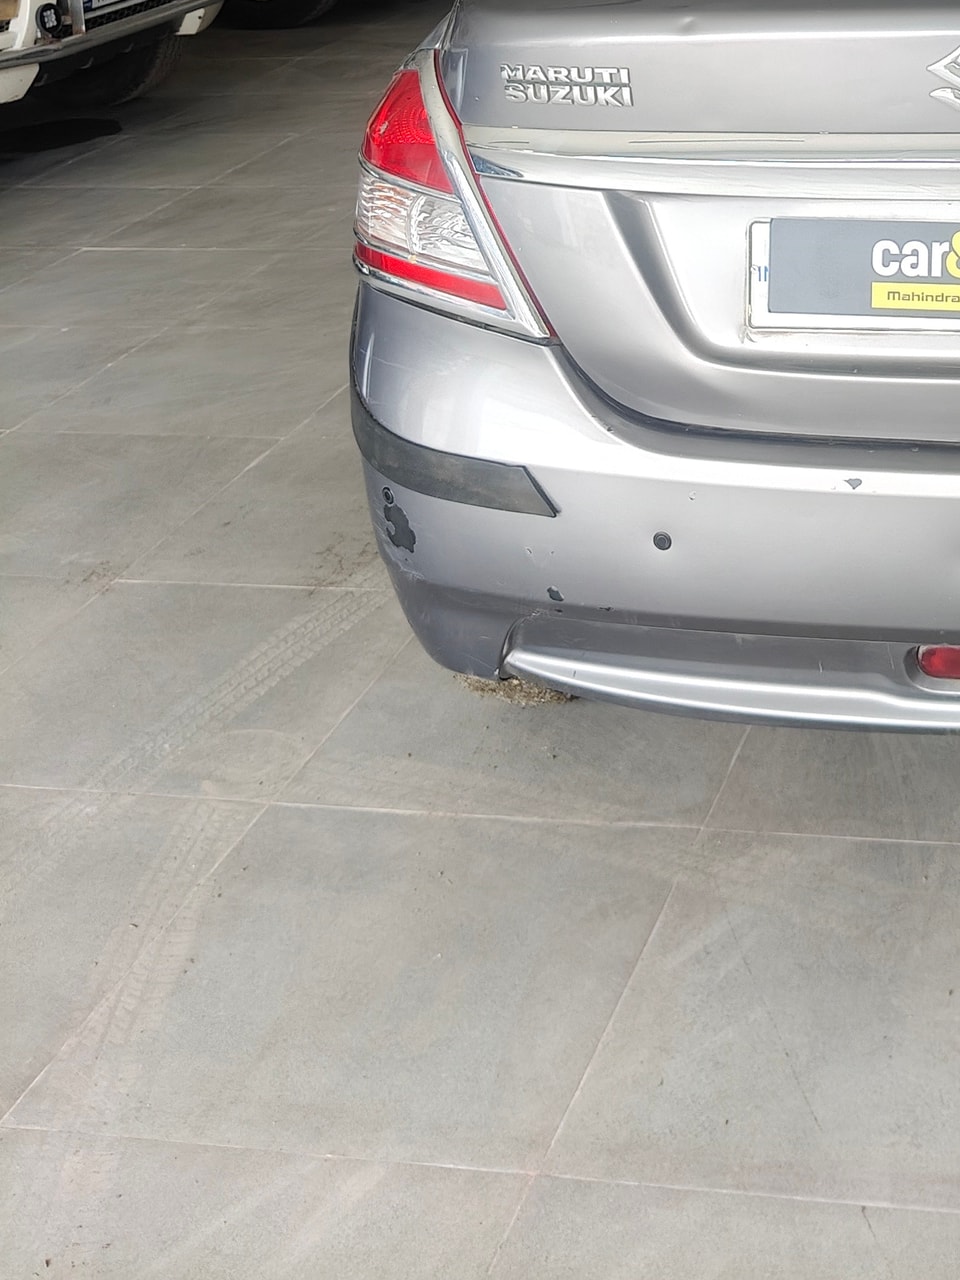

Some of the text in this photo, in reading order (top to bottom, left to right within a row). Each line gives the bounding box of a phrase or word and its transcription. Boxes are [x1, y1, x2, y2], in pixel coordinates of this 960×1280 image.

[500, 64, 631, 84] MARUTI
[504, 83, 634, 107] SUZUKI
[886, 289, 960, 303] Mahindra
